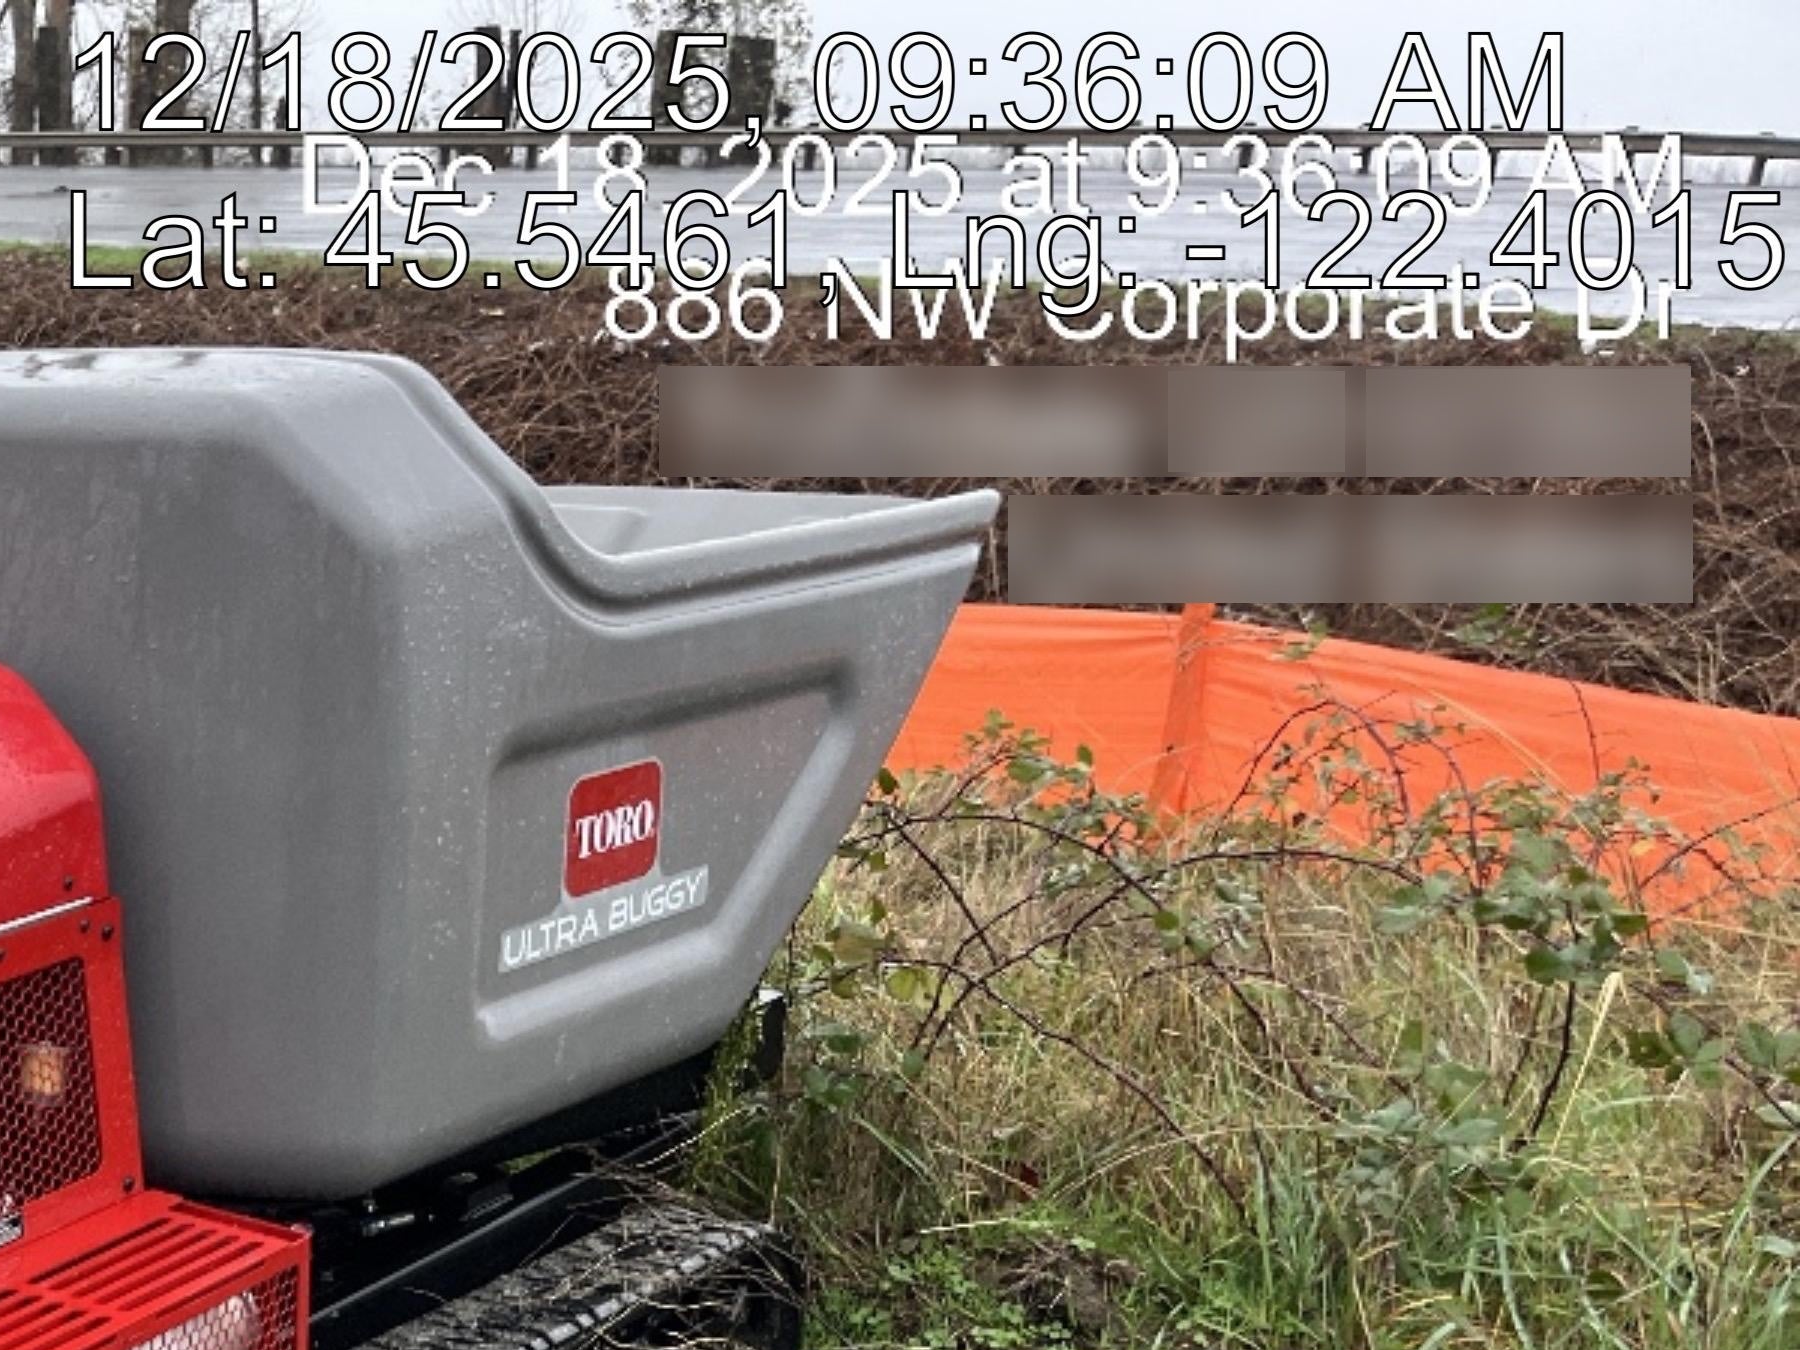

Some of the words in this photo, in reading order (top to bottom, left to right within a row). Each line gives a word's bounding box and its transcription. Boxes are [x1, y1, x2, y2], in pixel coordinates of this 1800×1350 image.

[575, 799, 655, 859] TORO
[503, 908, 600, 967] ULTRA
[608, 873, 701, 931] BUGGY
